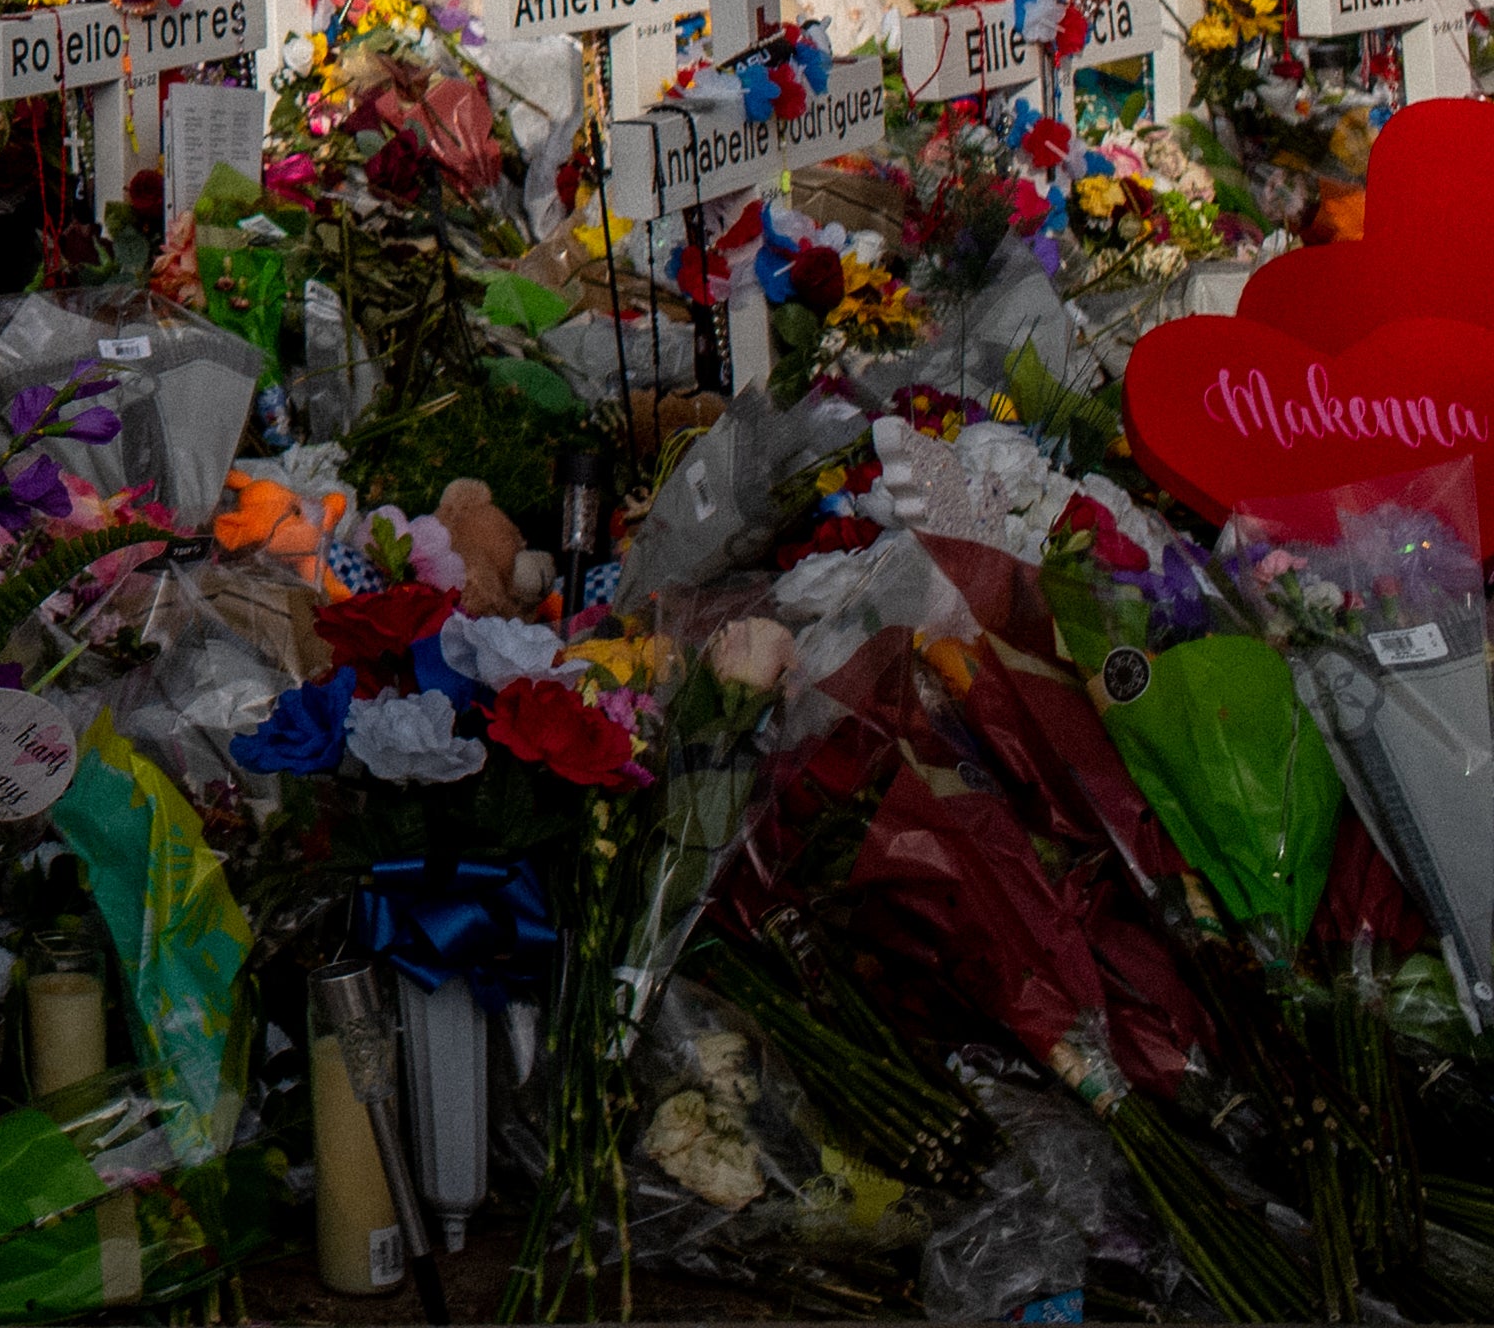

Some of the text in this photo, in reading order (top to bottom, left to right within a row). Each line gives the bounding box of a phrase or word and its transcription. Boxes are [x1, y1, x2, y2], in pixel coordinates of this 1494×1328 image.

[12, 1, 247, 82] Rojelio Torres
[966, 20, 1026, 78] Ellie
[652, 121, 769, 194] Annabelle
[1204, 362, 1489, 450] Makenna
